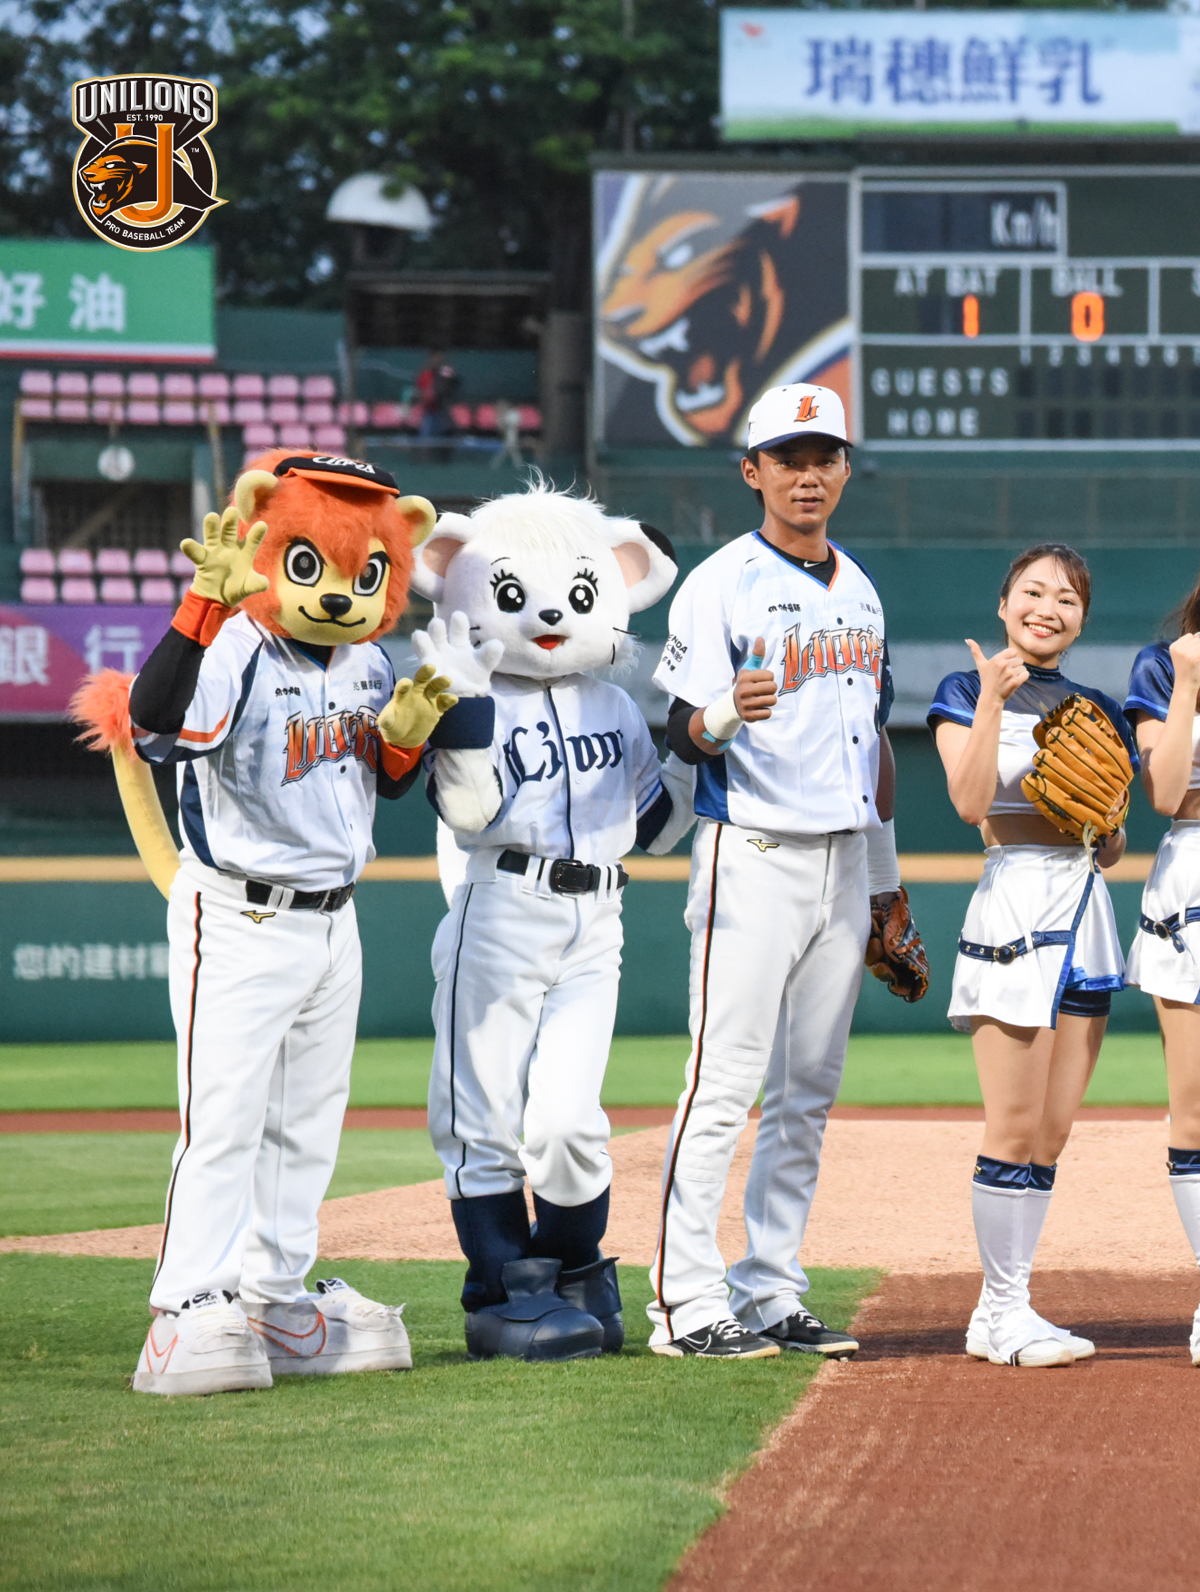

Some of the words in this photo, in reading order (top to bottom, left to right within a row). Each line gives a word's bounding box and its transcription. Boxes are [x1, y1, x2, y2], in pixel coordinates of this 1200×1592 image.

[805, 35, 1101, 104] 瑞穗鮮乳
[894, 265, 931, 297] AT
[945, 265, 1000, 297] BAT
[1051, 264, 1123, 297] BALL
[1071, 291, 1105, 342] 0
[871, 367, 1010, 397] GUESTS
[887, 407, 980, 437] HOME
[0, 624, 144, 685] 銀行
[502, 720, 624, 799] Lion
